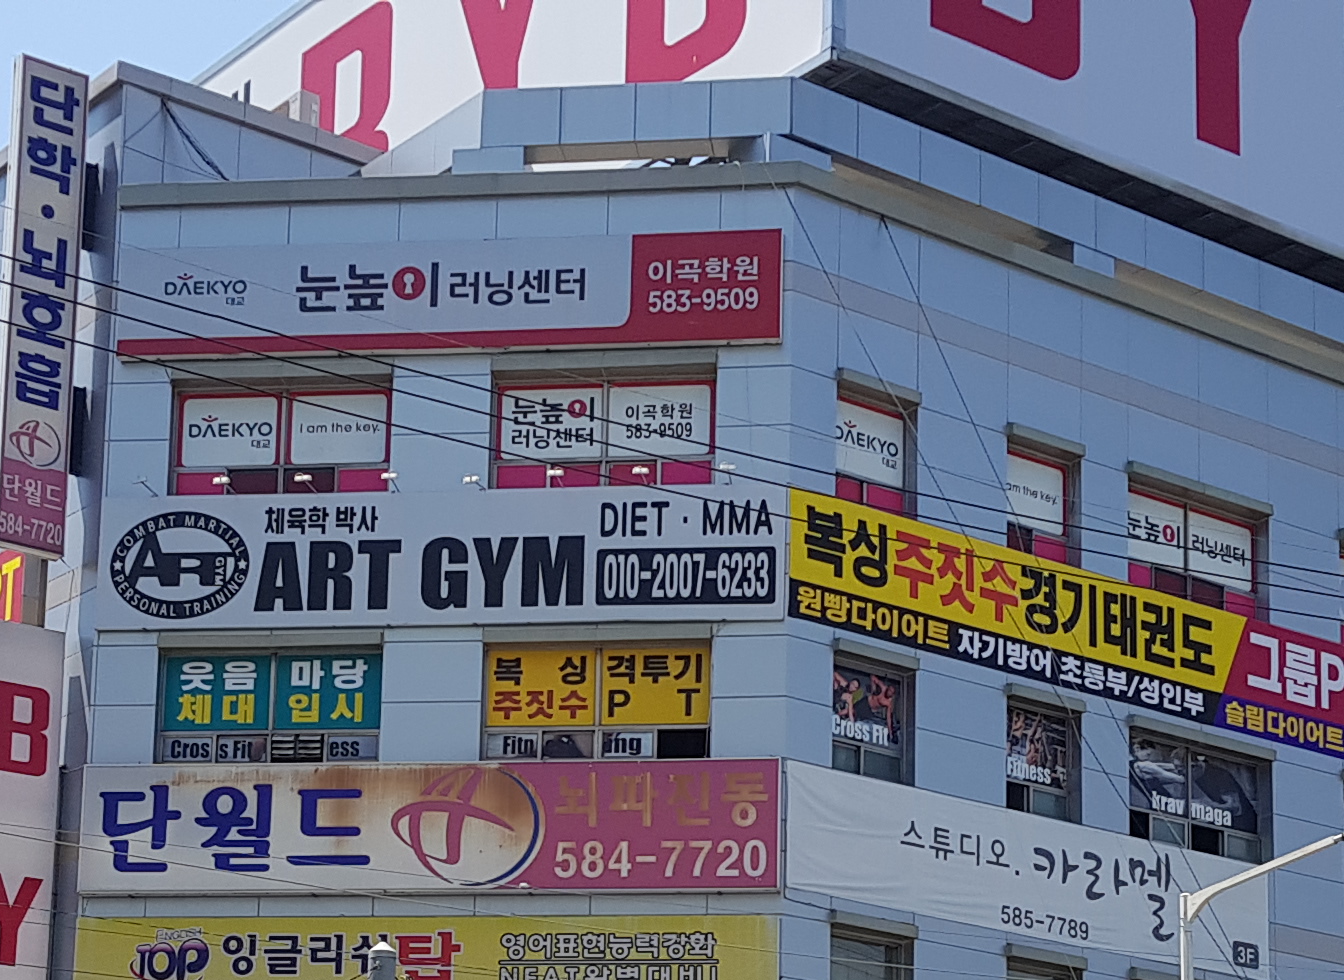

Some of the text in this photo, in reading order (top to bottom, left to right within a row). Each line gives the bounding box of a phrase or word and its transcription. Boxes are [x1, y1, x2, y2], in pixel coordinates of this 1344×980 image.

[164, 272, 248, 297] DAEKYO
[296, 262, 586, 312] 눈높이 러닝센터
[647, 257, 760, 284] 이곡학원
[647, 288, 759, 313] 583-9509
[189, 415, 273, 439] DAEKYO
[330, 421, 350, 434] the
[625, 402, 693, 421] 이곡학원
[511, 428, 594, 449] 러닝센터
[626, 422, 693, 441] 583-9509
[2, 473, 62, 511] 단월드
[0, 510, 63, 547] 584-7720
[116, 514, 246, 557] COMBAT MARTIAL
[265, 506, 378, 534] 체육학 박사
[601, 499, 773, 537] DIET MMA
[1191, 533, 1247, 568] 러닝센터
[253, 534, 585, 612] ART GYM
[602, 556, 770, 600] 010-2007-6233
[804, 504, 1216, 677] 복싱주짓수경기태권도
[112, 573, 246, 617] PERSONAL TRAINING
[180, 658, 369, 692] 웃음 마당
[608, 653, 705, 685] 격투기
[959, 628, 1053, 678] 자기방어
[1060, 656, 1206, 717] 초등부/성인부
[177, 690, 364, 725] 체대 입시
[493, 689, 589, 720] 주짓수
[831, 713, 870, 743] Cross
[1224, 702, 1344, 753] 슬림다이어트
[557, 771, 769, 829] 뇌파진동
[1190, 801, 1233, 828] maga
[99, 783, 372, 874] 단월드
[554, 839, 768, 879] 584-7720
[1033, 847, 1175, 943] 카라멜
[1001, 905, 1089, 942] 585-7789
[500, 931, 718, 959] 영어표현능력강화
[1236, 945, 1256, 964] 3F
